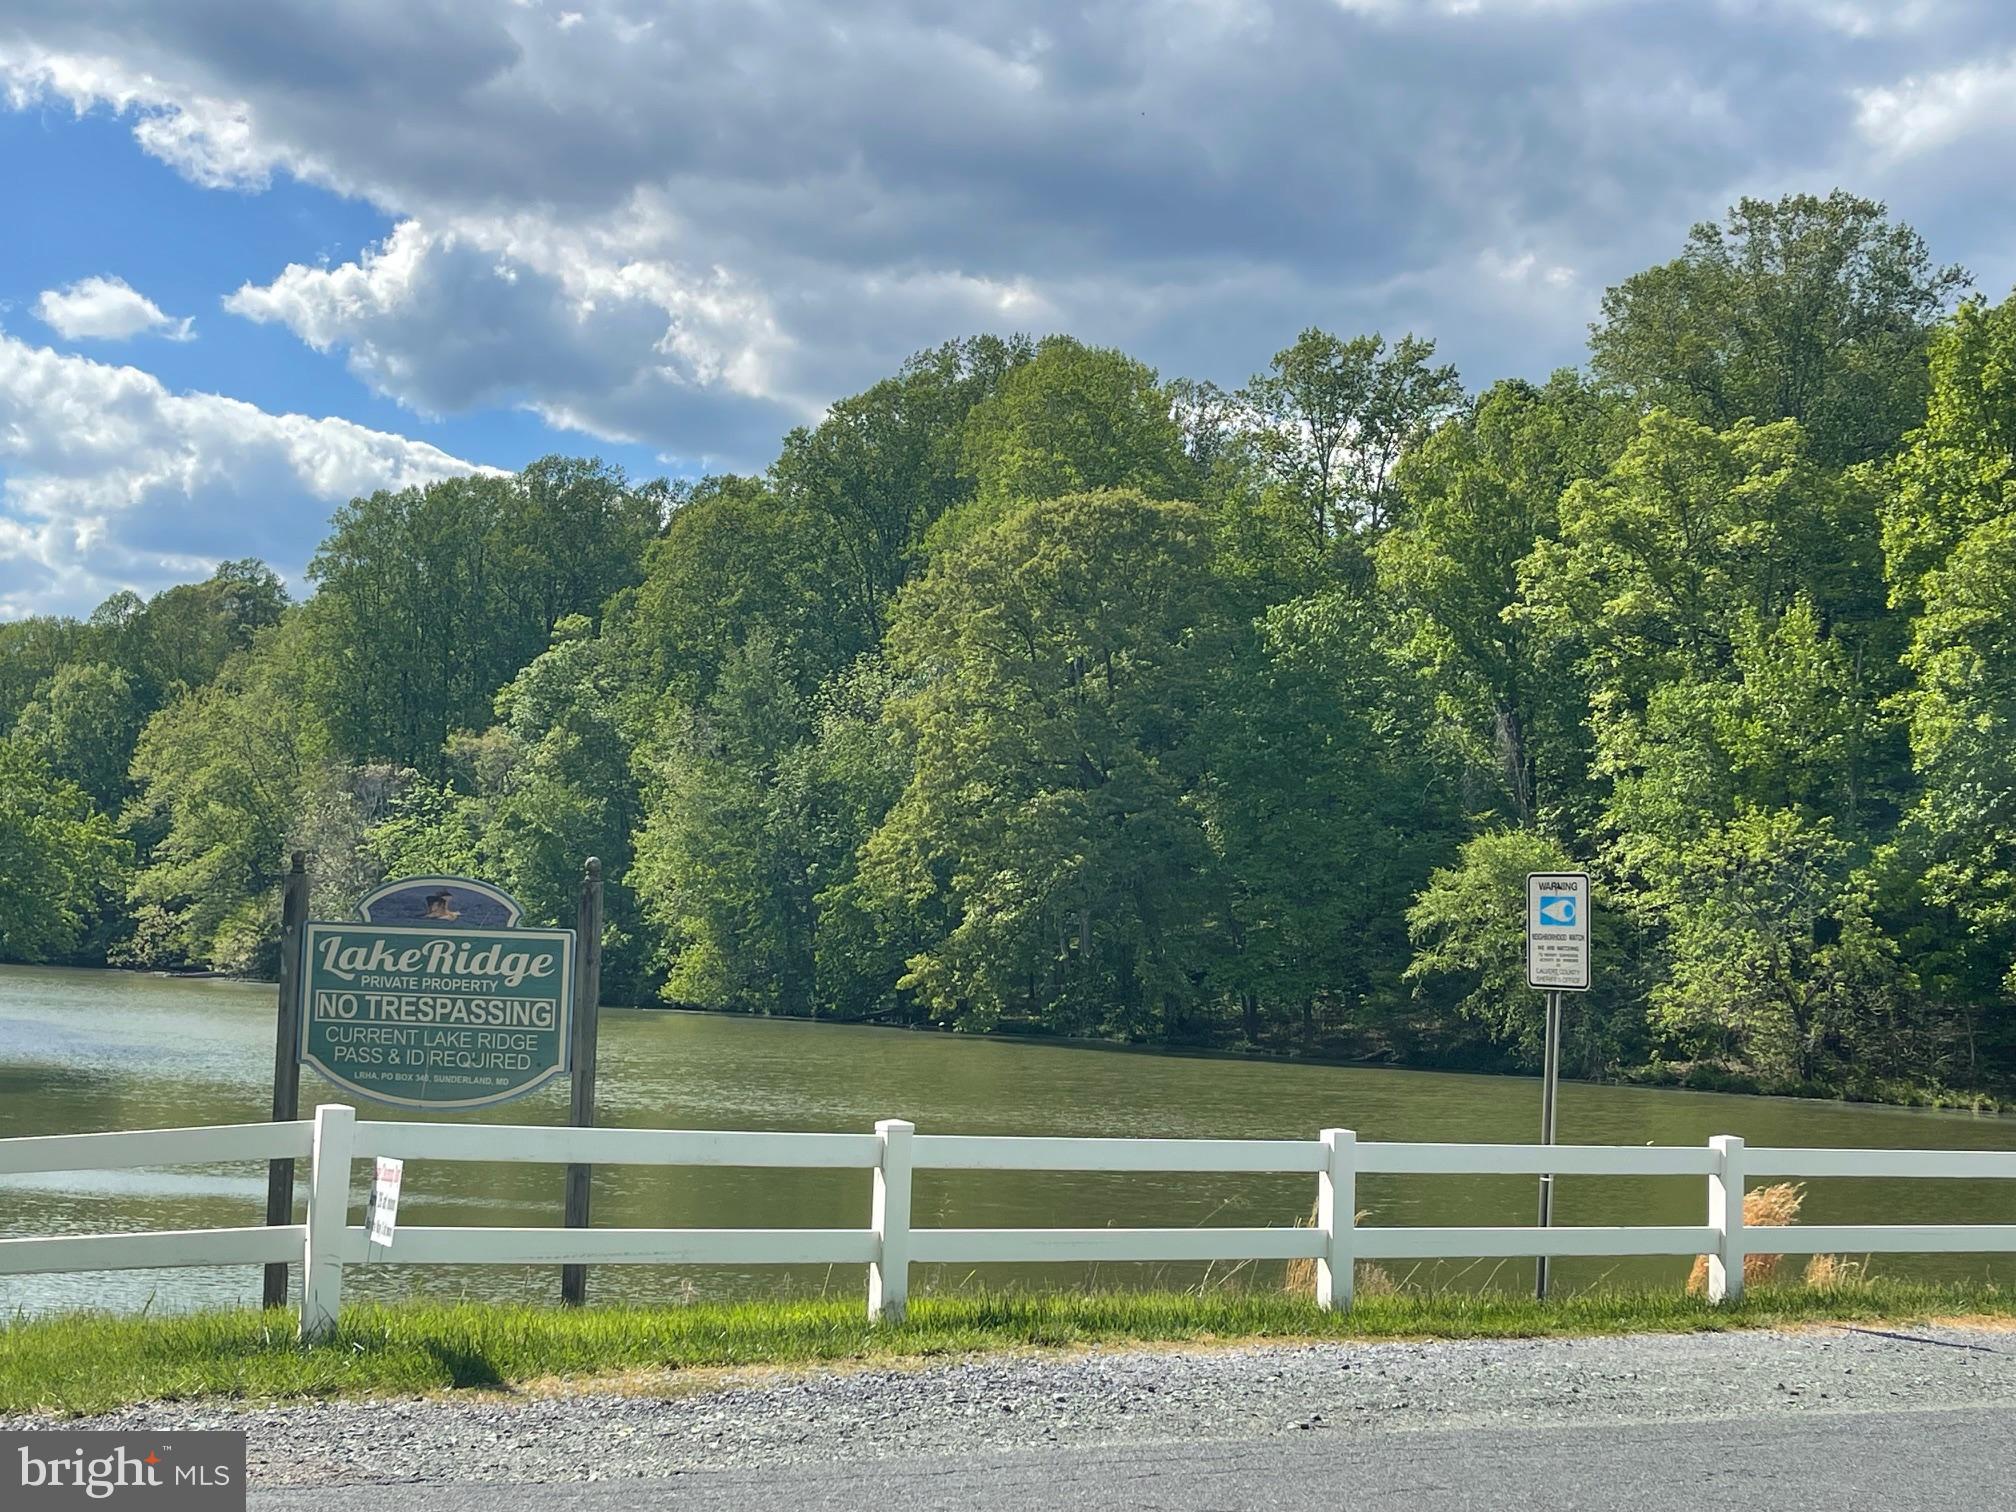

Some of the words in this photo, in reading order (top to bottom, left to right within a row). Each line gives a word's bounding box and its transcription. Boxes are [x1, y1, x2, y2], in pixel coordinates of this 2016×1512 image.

[1538, 881, 1578, 891] WARNING
[319, 936, 423, 980] Lake
[422, 940, 555, 987] Ridge
[361, 975, 418, 990] PRIVATE
[422, 977, 498, 992] PROPERTY
[319, 993, 358, 1019] NO
[365, 995, 552, 1027] TRESPASSING
[325, 1026, 418, 1045] CURRENT
[423, 1030, 473, 1048] LAKE
[477, 1032, 538, 1050] RIDGE
[334, 1046, 383, 1063] PASS
[388, 1048, 400, 1064] &
[406, 1049, 425, 1065] ID
[430, 1050, 531, 1070] REQUIRED
[381, 1072, 393, 1081] PO
[395, 1073, 413, 1082] BOX
[496, 1077, 510, 1086] MD
